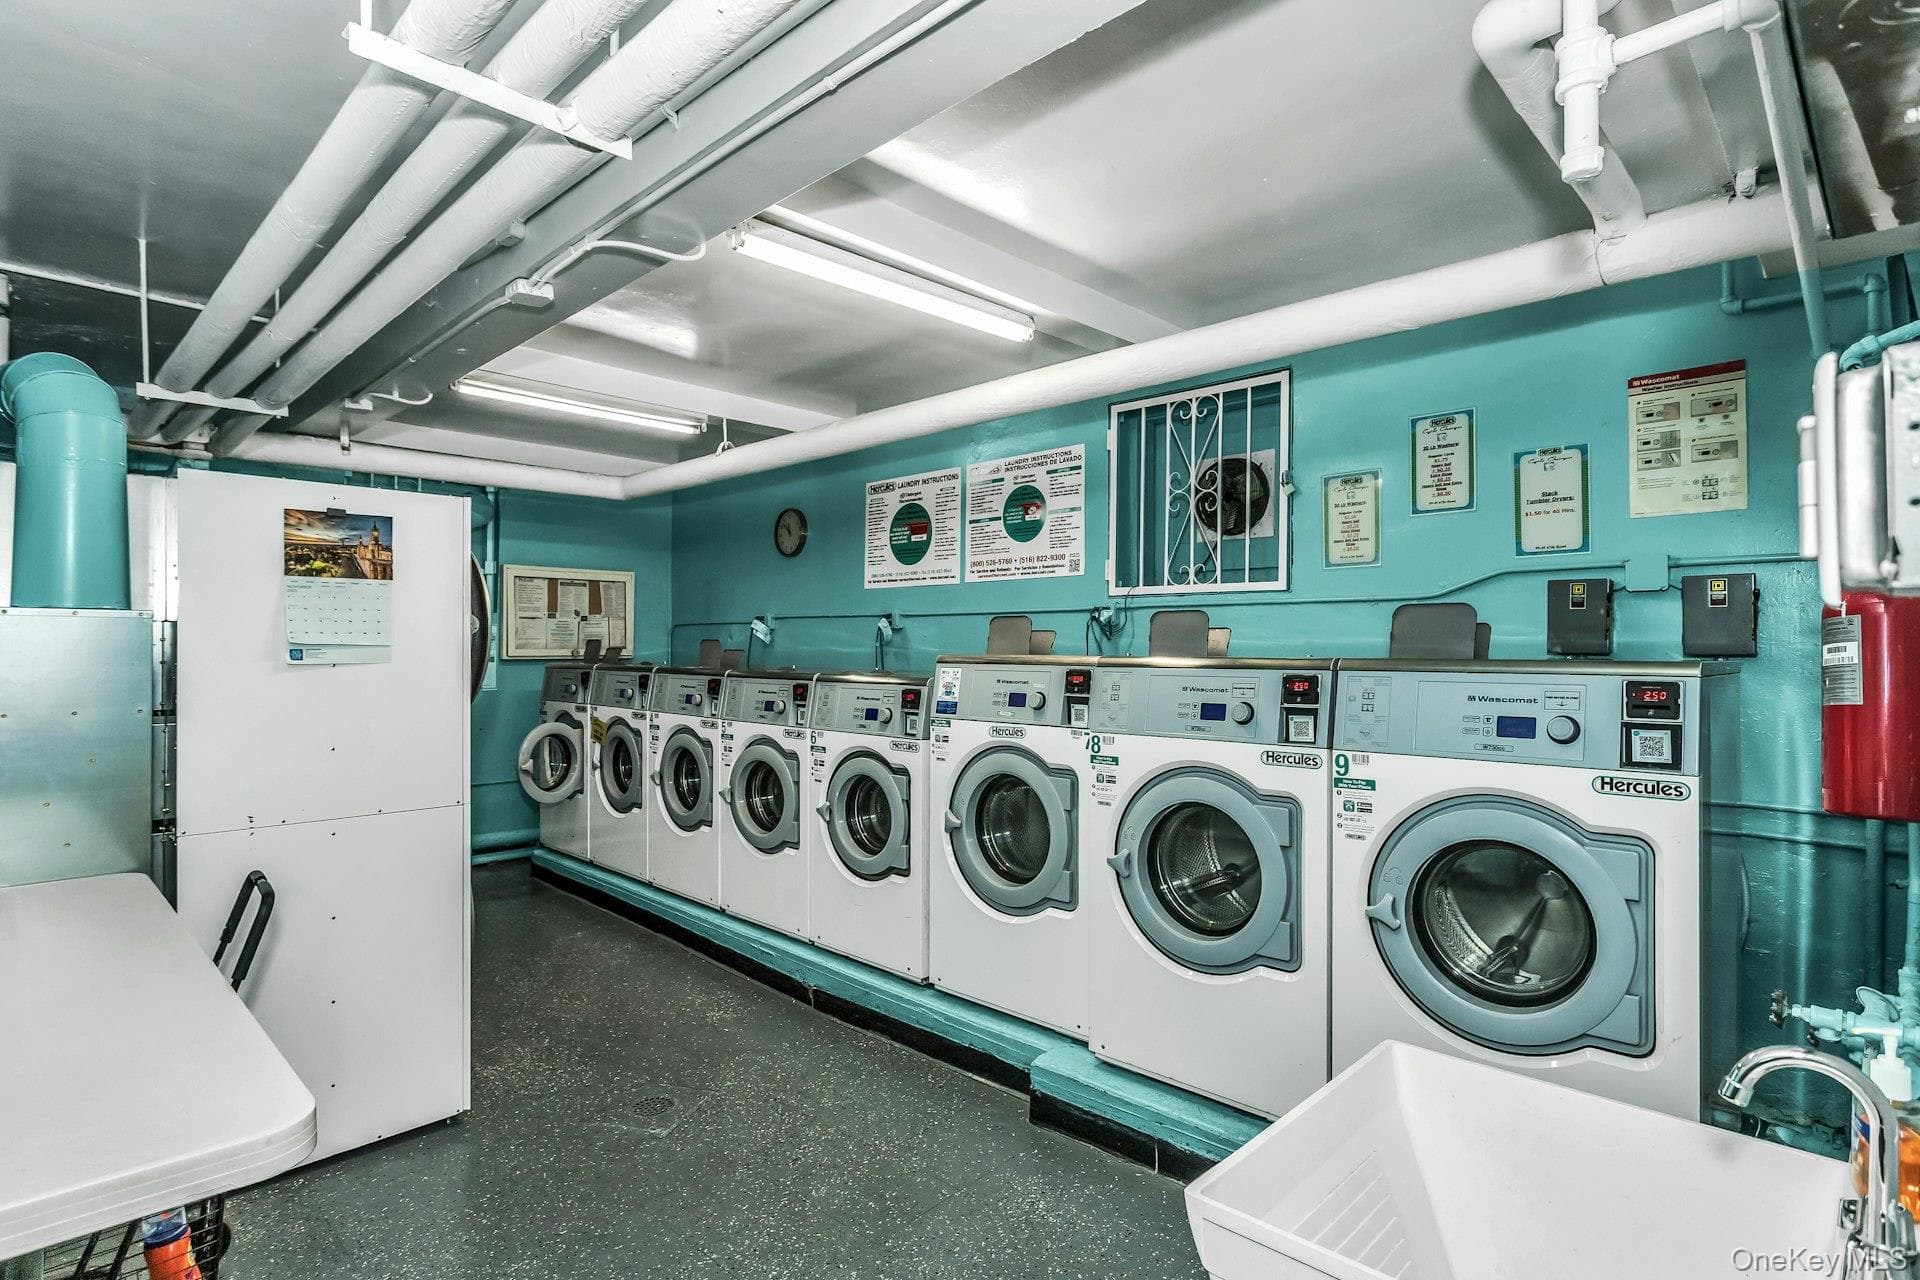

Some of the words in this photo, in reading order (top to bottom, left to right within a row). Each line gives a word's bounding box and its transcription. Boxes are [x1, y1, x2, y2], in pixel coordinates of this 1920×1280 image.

[1641, 374, 1680, 385] Wascomat
[1664, 380, 1698, 389] Instructions
[1431, 418, 1454, 426] Hercules
[1005, 458, 1029, 466] LAUNDRY
[1031, 450, 1072, 462] INSTRUCTIONS
[1539, 448, 1561, 456] Hercules
[1005, 462, 1048, 472] INSTRUCCIONES
[1059, 455, 1082, 463] LAVADO
[869, 482, 895, 493] Hercules
[898, 480, 920, 489] LAUNDRY
[922, 474, 959, 485] INSTRUCTIONS
[1341, 477, 1362, 485] Hercules
[970, 560, 984, 568] (800)
[986, 558, 1012, 566] 526-5760
[1020, 556, 1035, 564] (516)
[1037, 554, 1065, 562] 822-9300
[1478, 696, 1538, 704] Wascomat
[721, 721, 726, 733] 5
[991, 726, 1024, 736] Hercules
[811, 731, 816, 744] 6
[891, 741, 918, 751] Hercules
[1091, 735, 1100, 753] 8
[1266, 751, 1318, 767] Hercules
[1335, 753, 1349, 776] 9
[1600, 775, 1684, 798] Hercules
